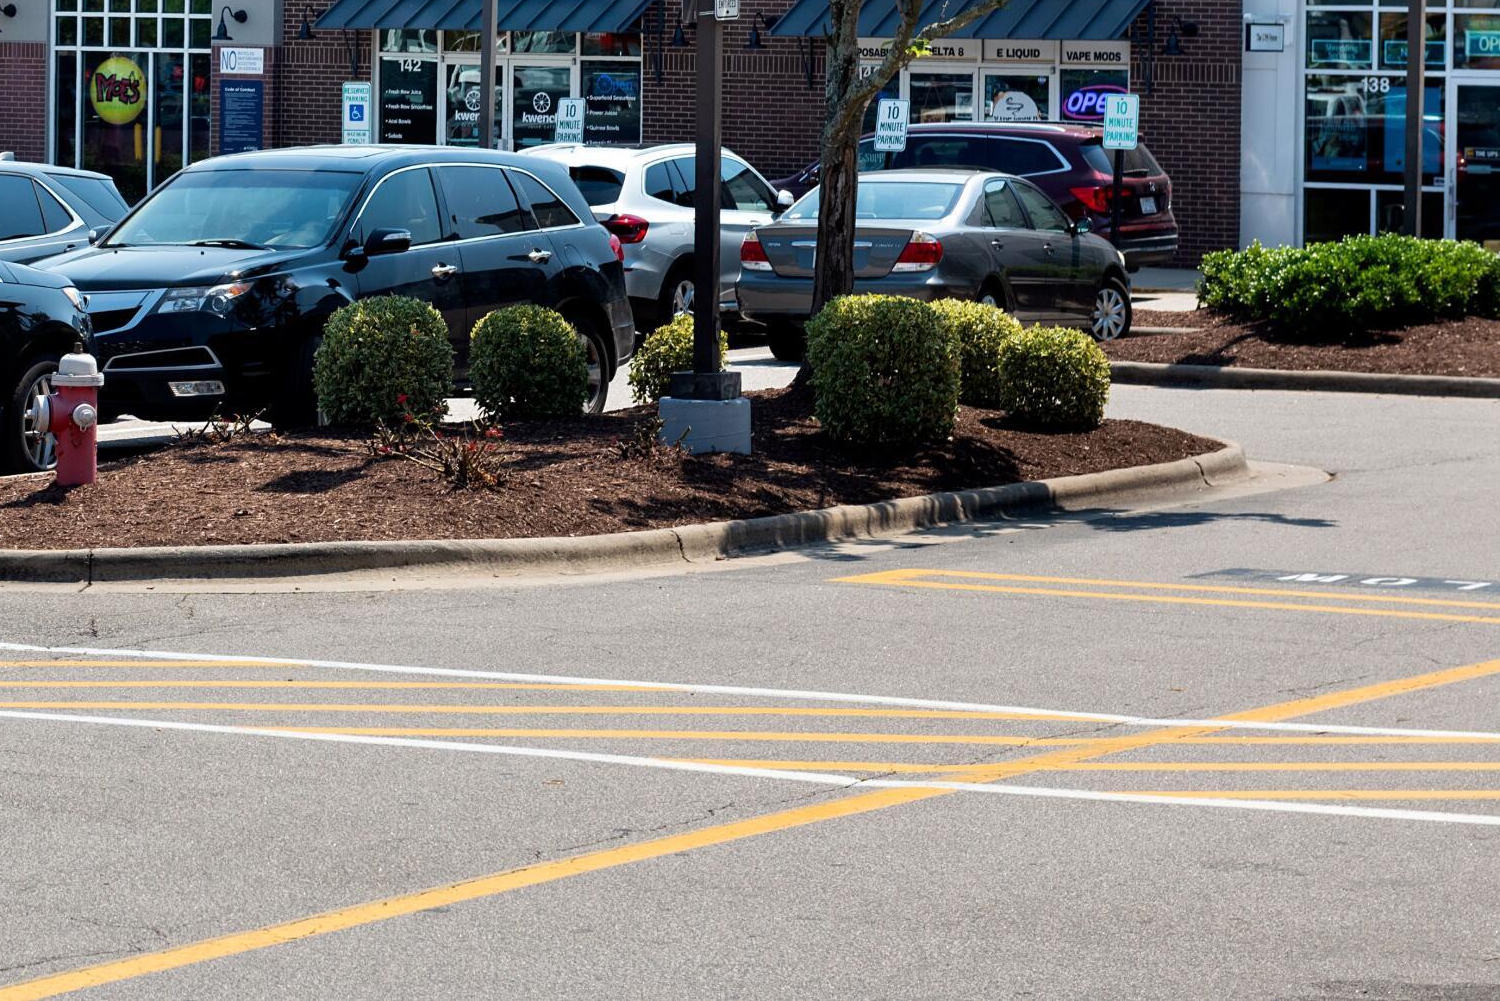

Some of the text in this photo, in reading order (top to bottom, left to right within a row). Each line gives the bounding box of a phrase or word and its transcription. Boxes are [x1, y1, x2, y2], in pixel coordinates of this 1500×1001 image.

[719, 0, 736, 9] ENFORCED
[958, 47, 964, 56] 8
[997, 48, 1040, 59] E LIQUID
[1066, 51, 1121, 61] VAPE MODS
[222, 50, 237, 71] NO
[398, 58, 422, 72] 142
[1361, 77, 1390, 93] 138
[343, 87, 369, 95] RESERVED
[345, 95, 368, 103] PARKING
[1067, 91, 1107, 114] OPE
[565, 104, 577, 118] 10
[887, 105, 900, 119] 10
[1116, 101, 1128, 115] 10
[522, 111, 557, 124] kwenc
[1108, 118, 1134, 128] MINUTE
[558, 119, 581, 130] MINUTE
[879, 121, 904, 132] MINUTE
[557, 132, 581, 143] PARKING
[876, 134, 904, 145] PARKING
[1106, 134, 1135, 142] PARKING
